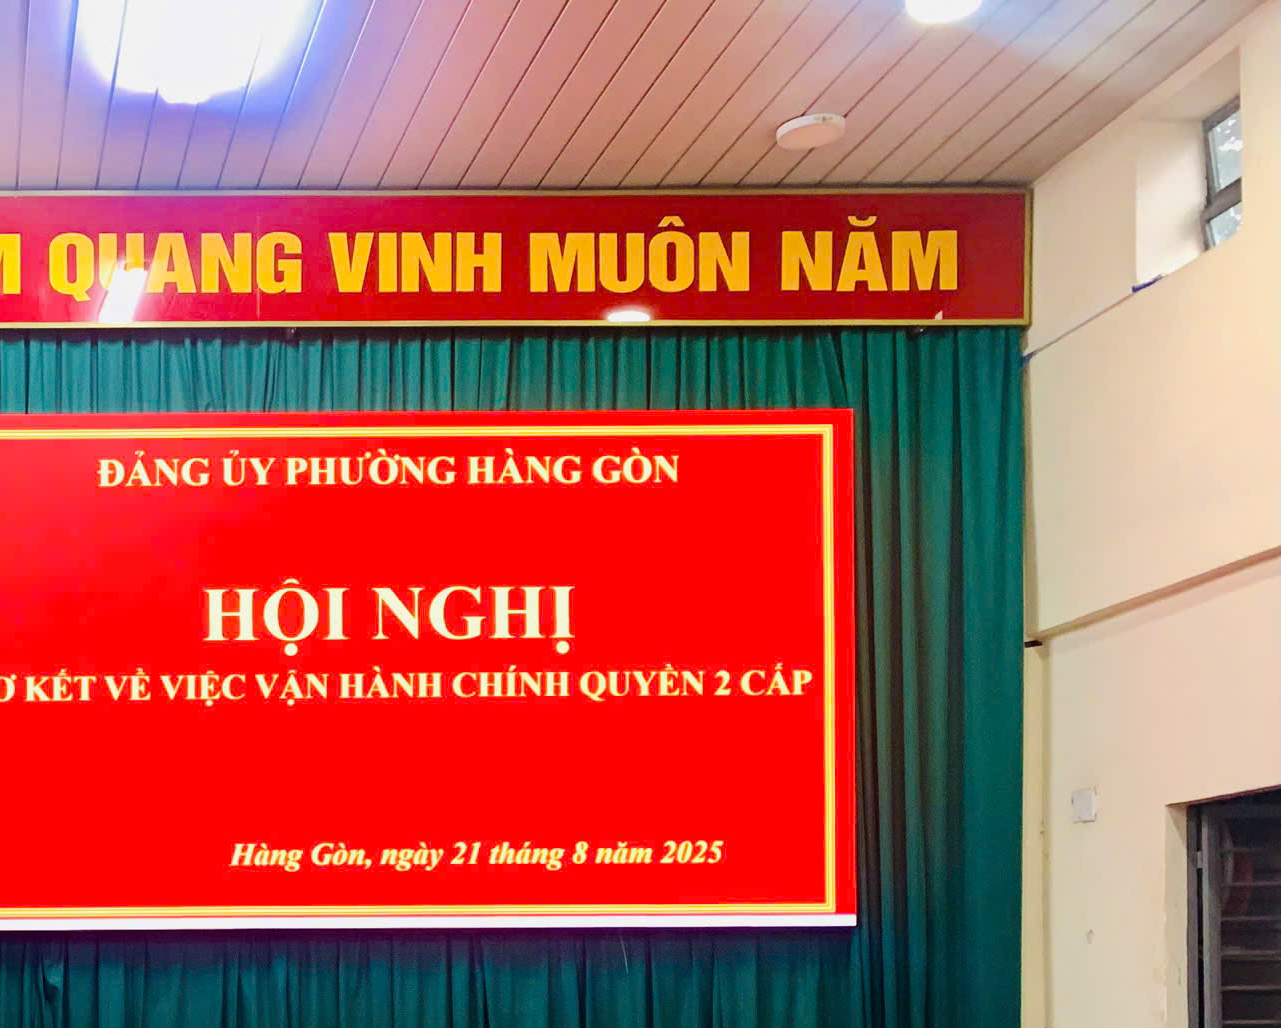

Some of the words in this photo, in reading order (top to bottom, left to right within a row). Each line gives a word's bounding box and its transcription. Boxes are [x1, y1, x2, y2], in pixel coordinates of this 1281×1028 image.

[48, 231, 303, 302] QUANG
[328, 231, 502, 293] VINH
[529, 215, 751, 293] MUÔN
[781, 215, 958, 291] NĂM
[97, 450, 209, 487] ĐẢNG
[223, 450, 275, 486] ỦY
[286, 449, 456, 485] PHƯỜNG
[468, 448, 581, 484] HÀNG
[593, 447, 679, 483] GÒN
[204, 578, 348, 656] HỘI
[372, 586, 575, 654] NGHỊ
[25, 669, 96, 701] KẾT
[105, 668, 151, 700] VỀ
[161, 671, 245, 706] VIỆC
[255, 670, 328, 706] VẬN
[340, 666, 441, 698] HÀNH
[453, 665, 569, 697] CHÍNH
[580, 664, 703, 701] QUYỀN
[715, 670, 731, 696] 2
[741, 663, 812, 695] CẤP
[231, 843, 303, 872] Hàng
[311, 843, 372, 869] Gòn,
[380, 842, 444, 871] ngày
[450, 842, 481, 864] 21
[489, 842, 565, 870] tháng
[572, 841, 588, 864] 8
[595, 842, 652, 864] năm
[660, 840, 723, 863] 2025
